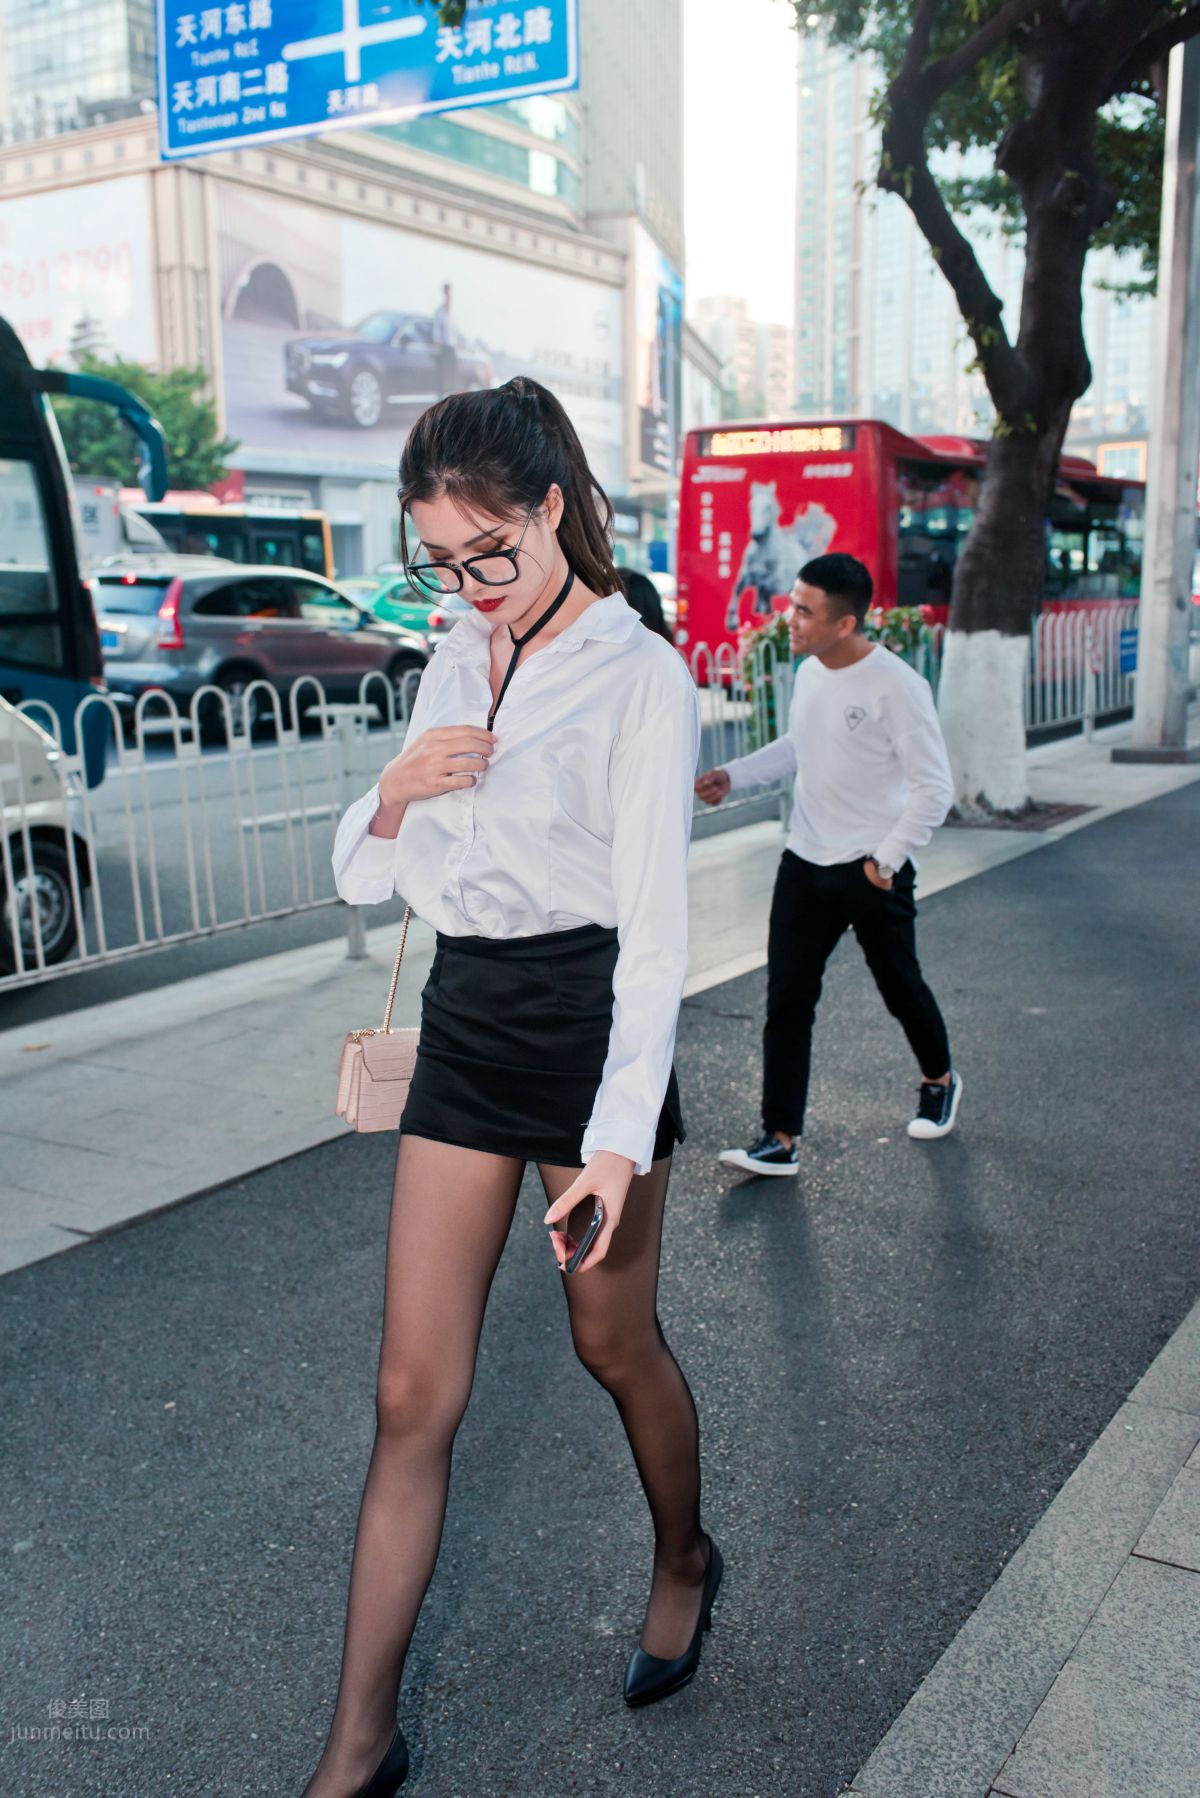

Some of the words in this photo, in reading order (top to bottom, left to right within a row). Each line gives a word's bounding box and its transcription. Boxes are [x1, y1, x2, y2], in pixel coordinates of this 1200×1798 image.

[175, 0, 273, 48] 天河东路
[435, 6, 554, 64] 天河北路
[172, 61, 289, 114] 天河南二路
